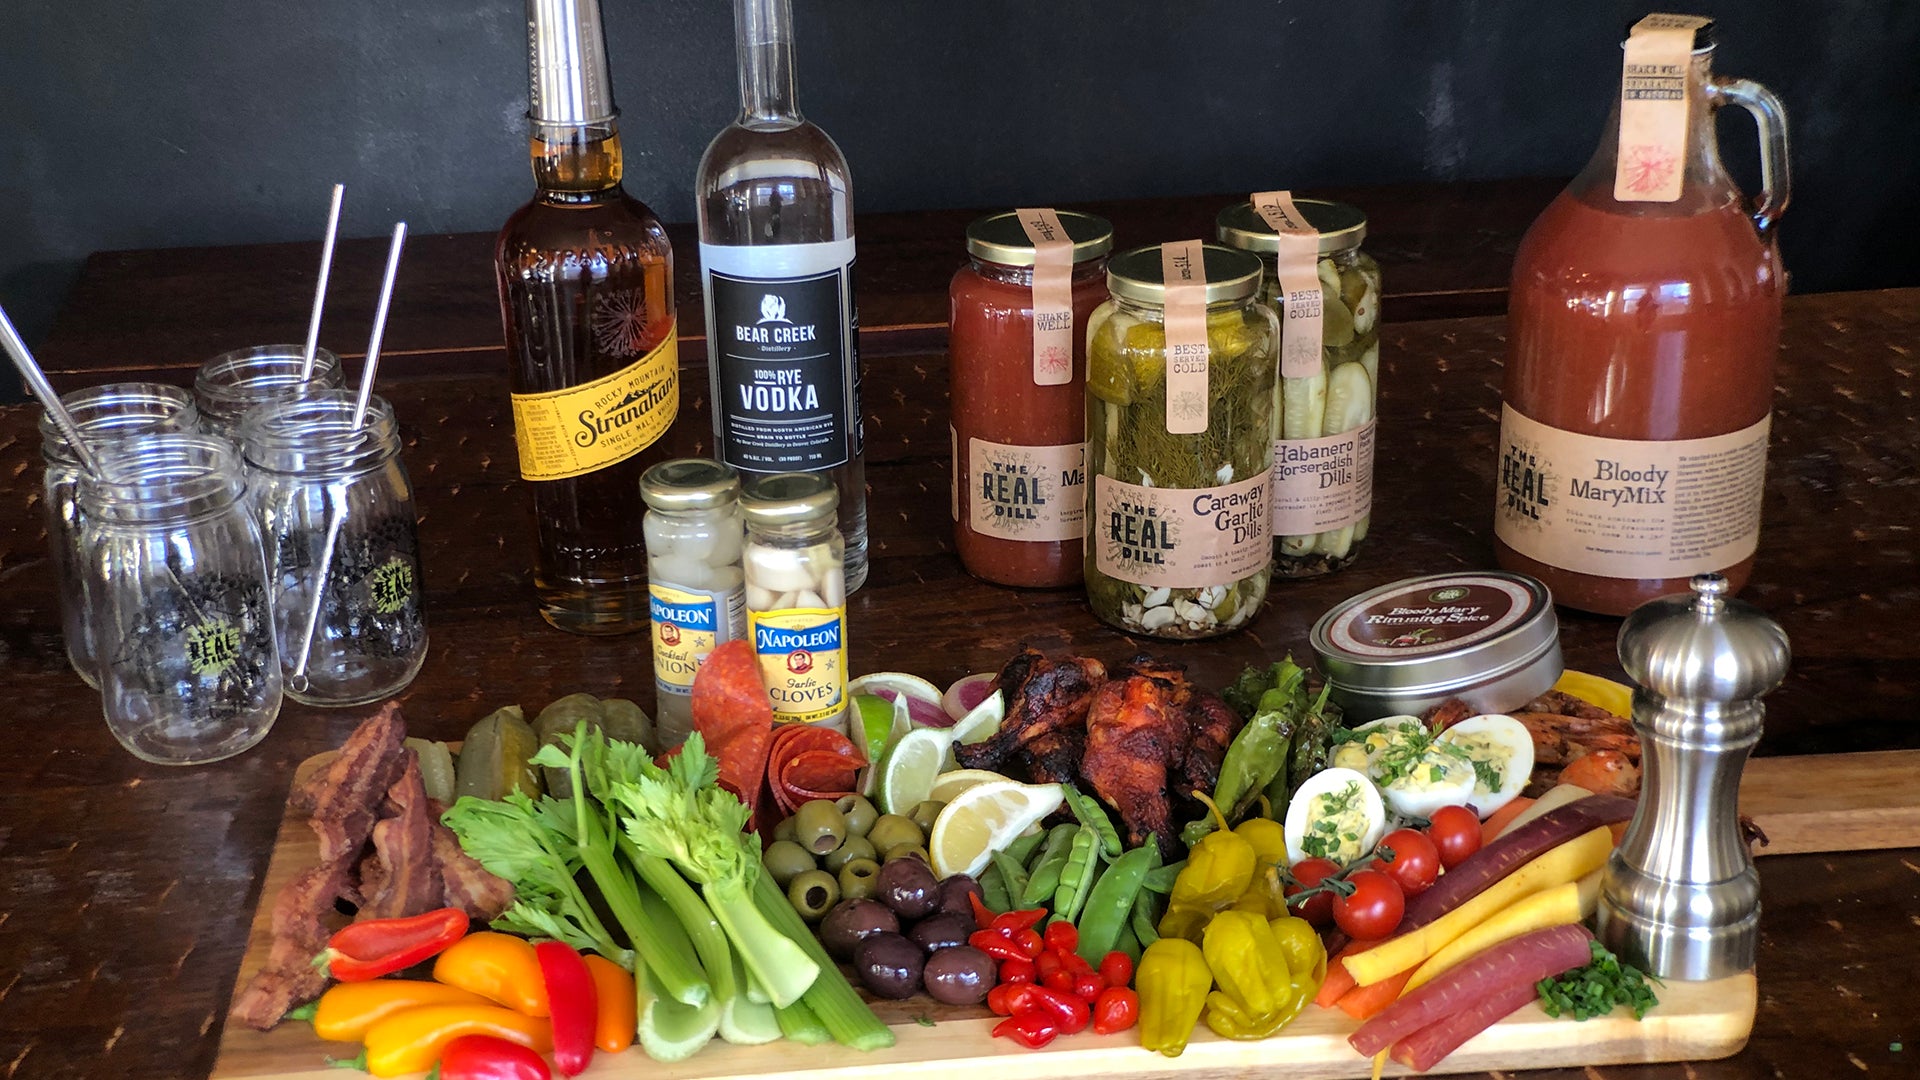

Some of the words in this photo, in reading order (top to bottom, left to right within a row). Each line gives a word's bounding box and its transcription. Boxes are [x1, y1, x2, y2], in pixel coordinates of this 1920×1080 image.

[1290, 290, 1321, 302] BEST
[1037, 312, 1071, 321] SHAKE
[1290, 308, 1321, 319] COLD
[736, 325, 769, 343] BEAR
[774, 325, 817, 343] CREEK
[1037, 320, 1071, 331] WELL
[1173, 355, 1206, 363] SERVED
[1174, 344, 1206, 355] BEST
[754, 370, 776, 380] 100%
[777, 369, 802, 385] RYE
[1173, 363, 1206, 374] COLD
[595, 387, 624, 410] ROCKY
[629, 365, 666, 389] MOUNTAIN
[740, 384, 819, 412] VODKA
[600, 431, 632, 448] SINGLE
[636, 416, 655, 433] MALT
[1275, 441, 1353, 464] Habanero
[1511, 445, 1536, 467] THE
[993, 462, 1028, 475] THE
[1274, 454, 1352, 481] Horseradish
[1593, 459, 1669, 489] Bloody
[983, 472, 1045, 505] REAL
[1319, 468, 1352, 489] Dills
[1503, 454, 1549, 506] REAL
[1121, 502, 1157, 518] THE
[1193, 483, 1265, 516] Caraway
[1508, 493, 1539, 520] DILL
[995, 505, 1036, 520] DILL
[1215, 502, 1264, 531] Garlic
[1111, 512, 1175, 550] REAL
[1233, 521, 1262, 545] Dills
[1122, 546, 1165, 565] DILL
[1364, 614, 1447, 625] Rimming
[1446, 612, 1490, 624] Spice
[1388, 606, 1438, 616] Bloody
[1439, 605, 1481, 615] Mary
[190, 633, 235, 659] REAL
[757, 625, 839, 649] NAPOLEON
[656, 657, 705, 675] NION
[770, 682, 833, 703] CLOVES
[787, 677, 817, 689] Garlic
